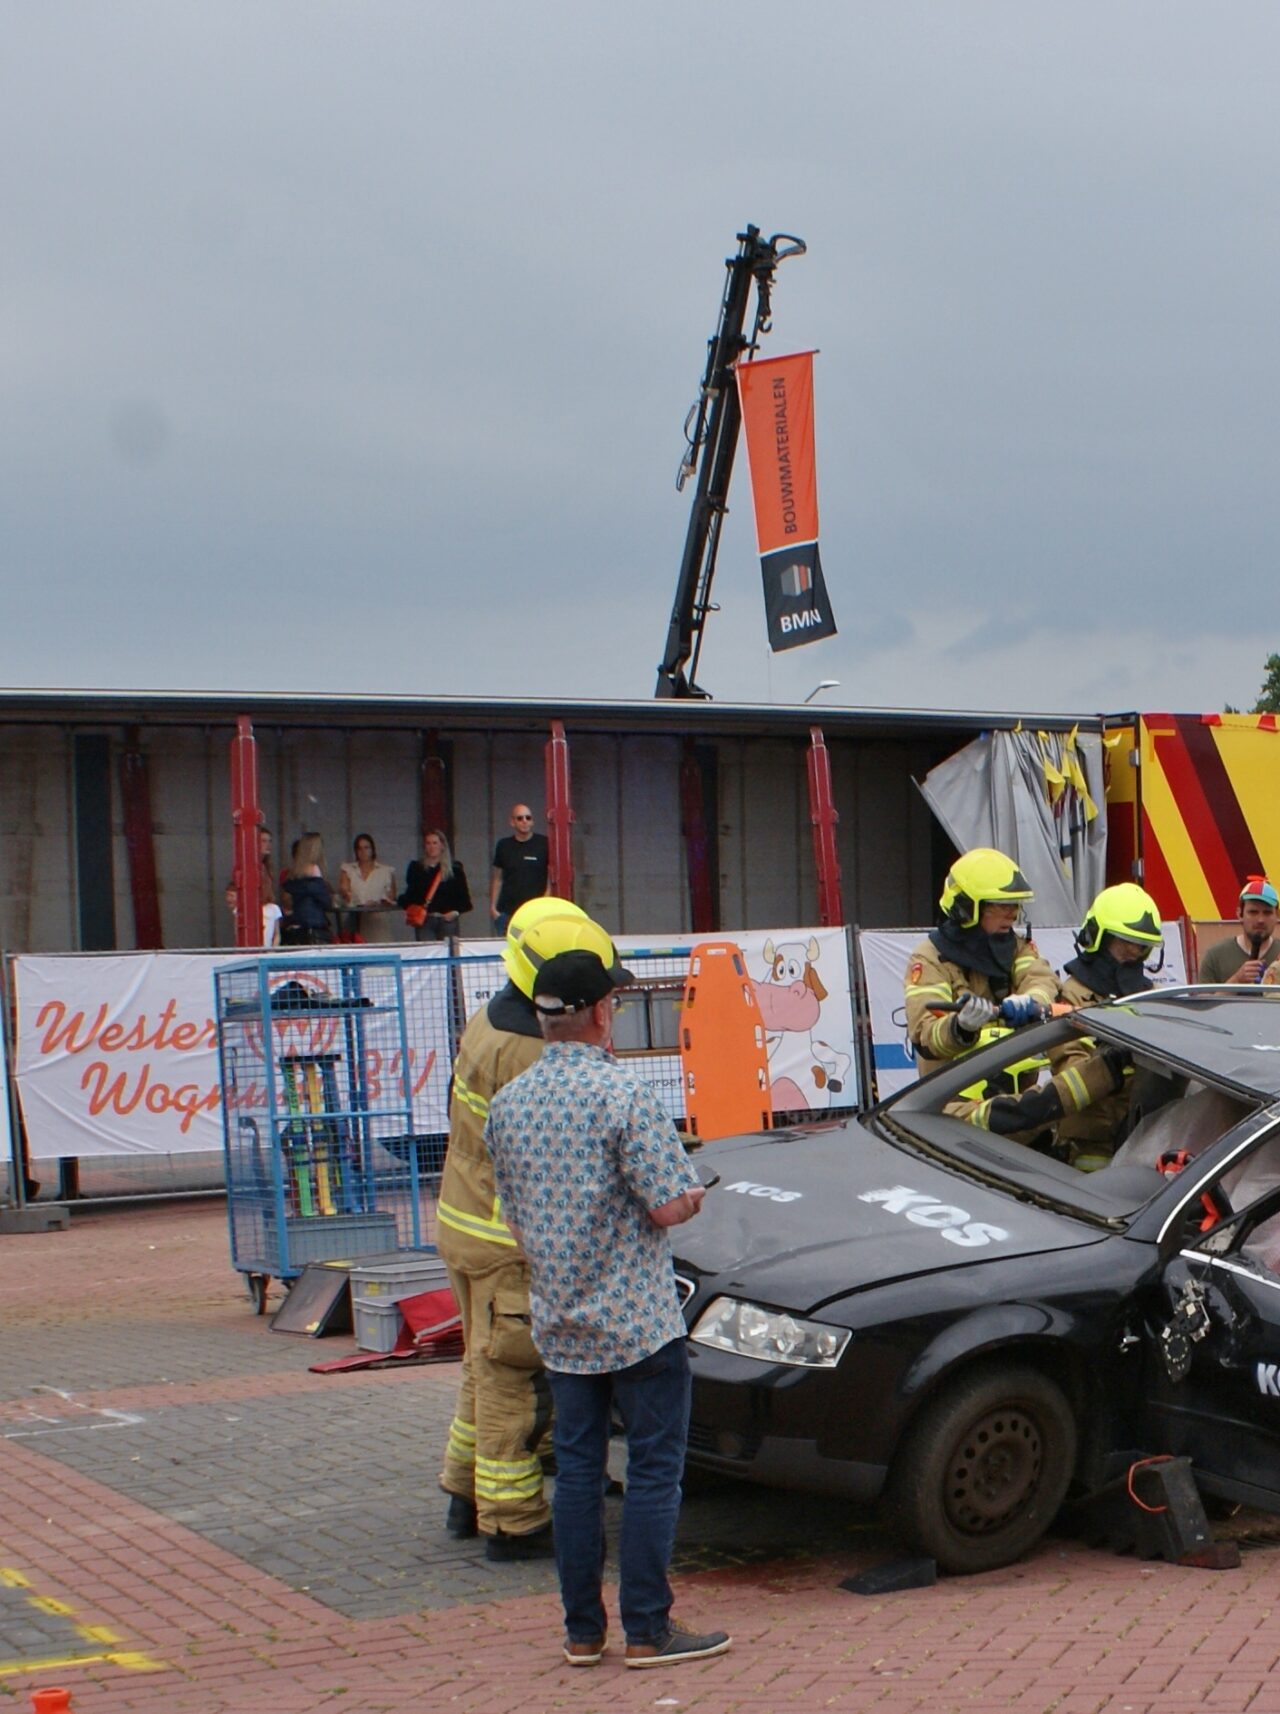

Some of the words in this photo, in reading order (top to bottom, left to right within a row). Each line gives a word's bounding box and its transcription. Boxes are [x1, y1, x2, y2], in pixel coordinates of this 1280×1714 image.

[772, 376, 798, 535] BOUWMATERIALEN
[780, 608, 822, 634] BMN
[724, 1181, 804, 1203] KOS
[857, 1184, 1011, 1247] KOS
